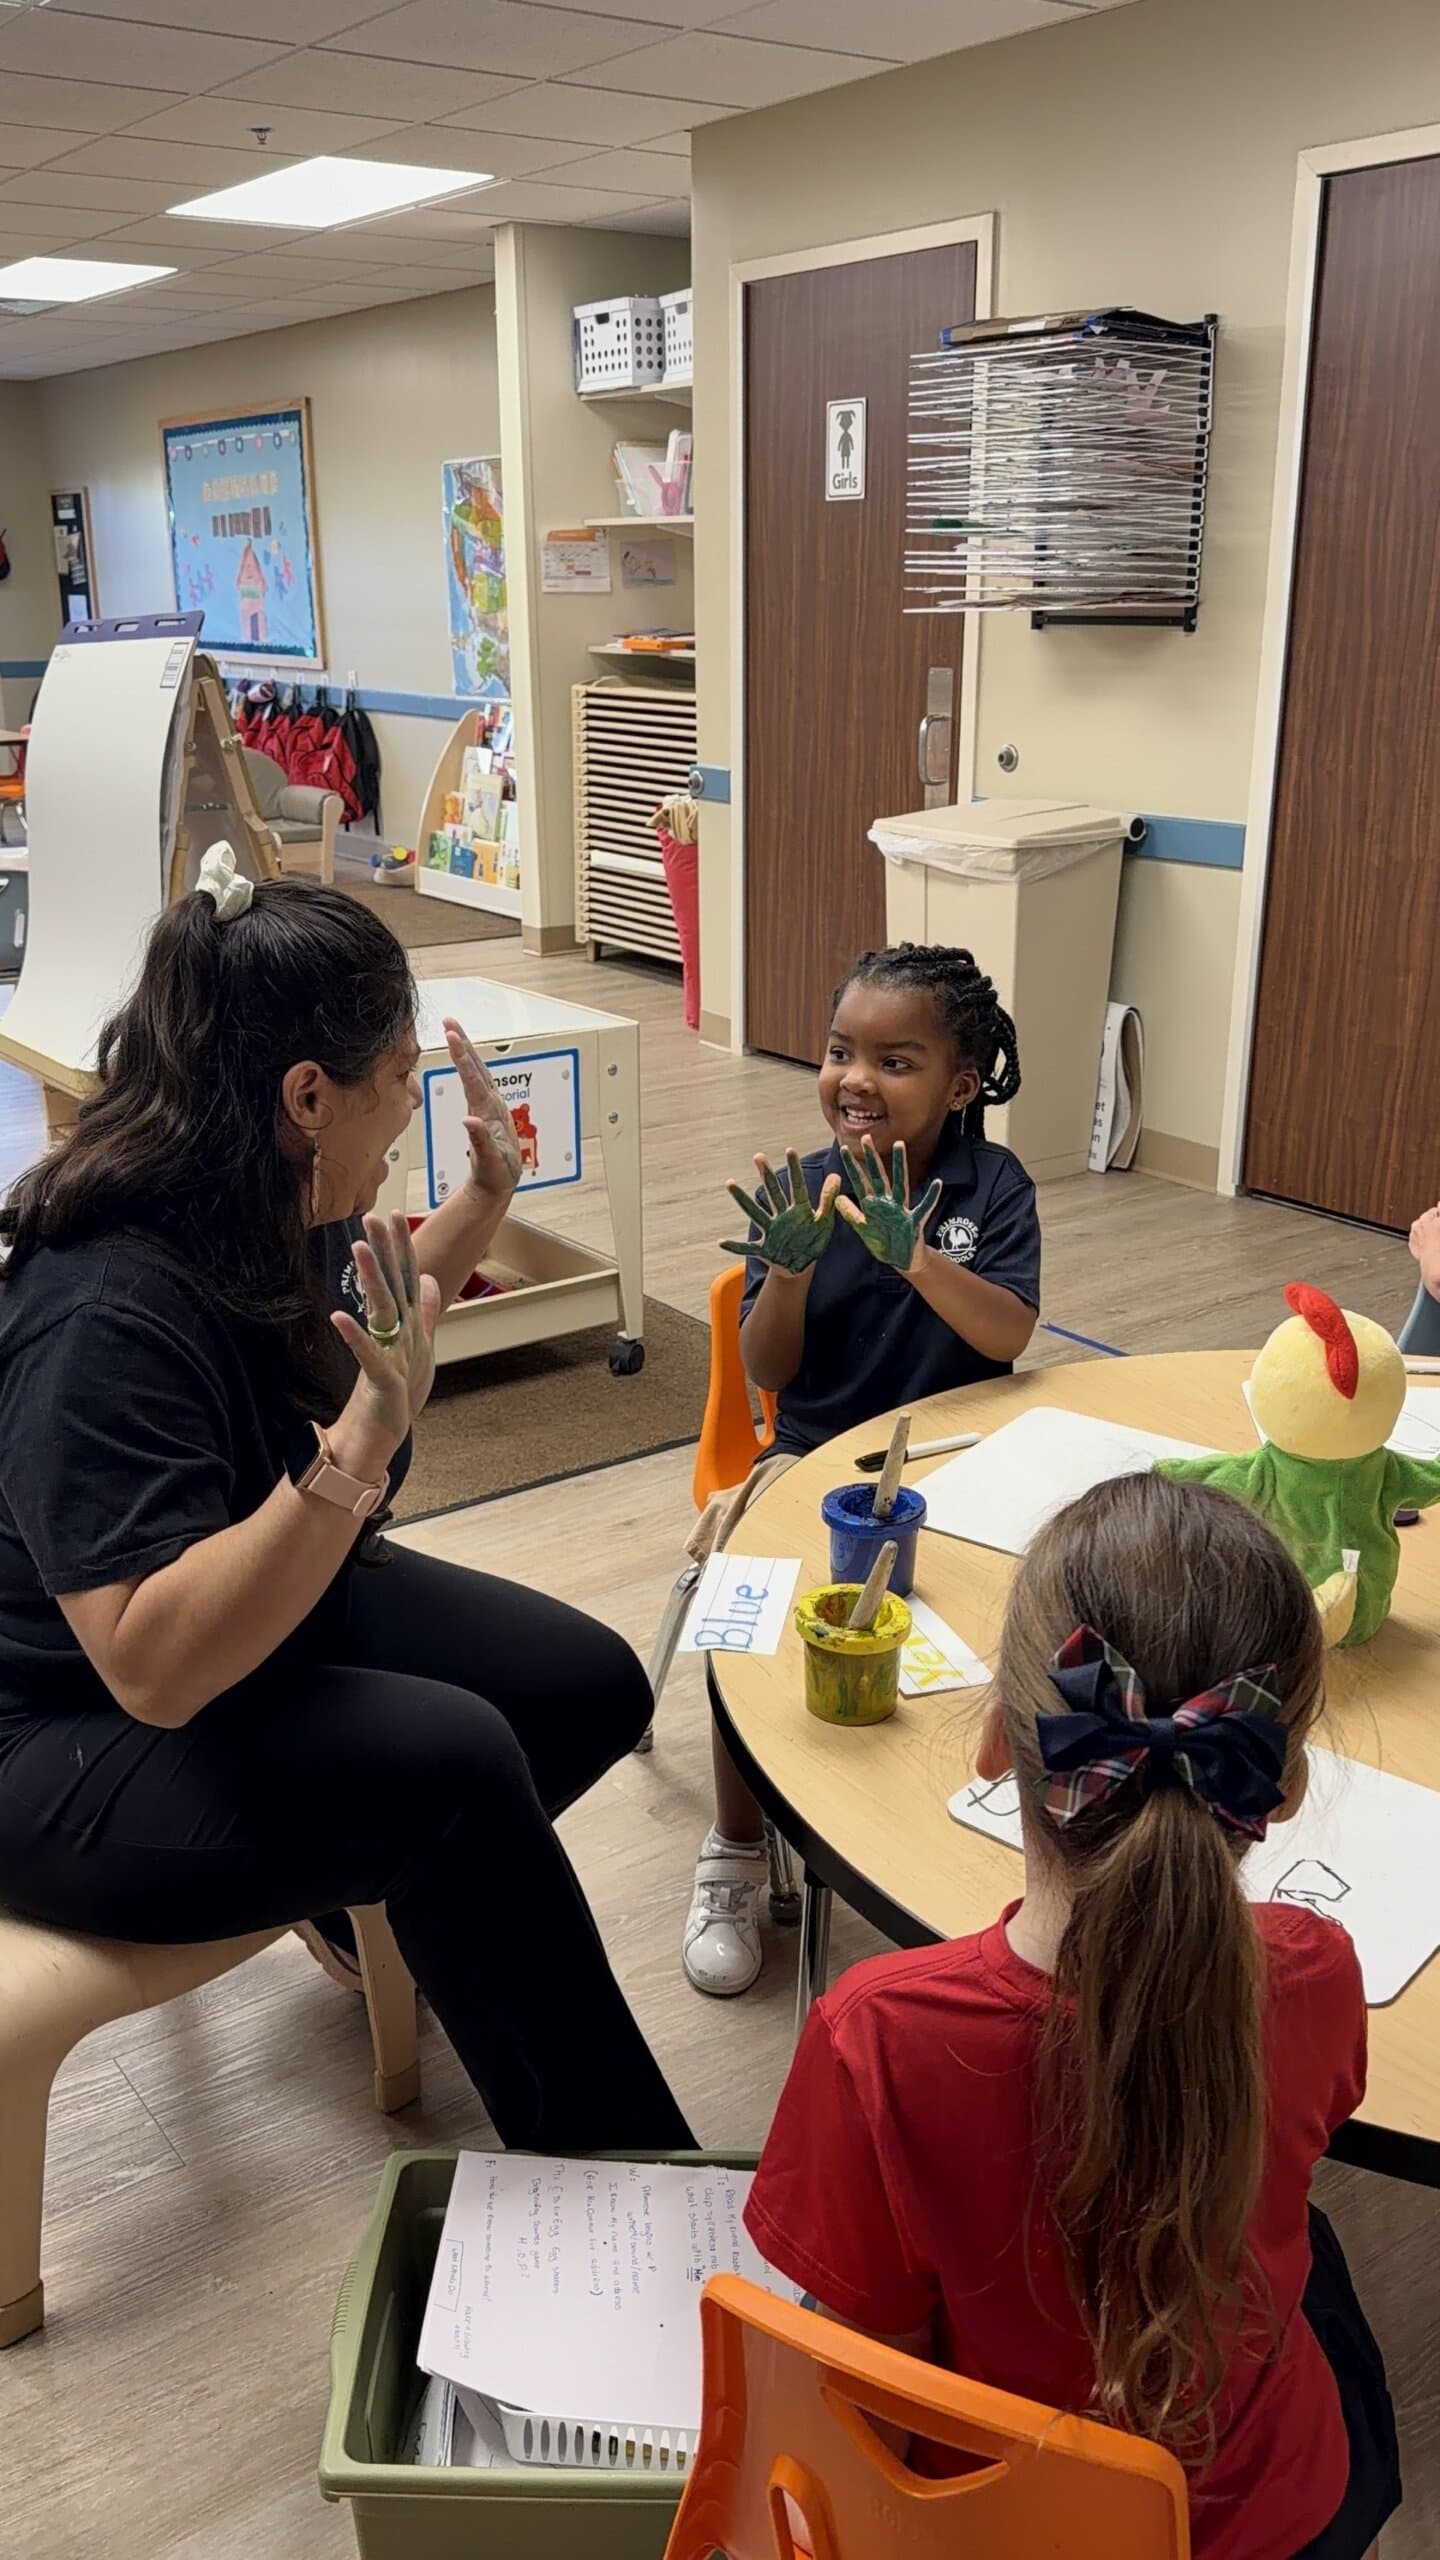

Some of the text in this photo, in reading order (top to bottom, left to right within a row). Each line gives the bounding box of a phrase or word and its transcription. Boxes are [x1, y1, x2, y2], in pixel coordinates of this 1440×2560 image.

[832, 471, 858, 490] Girls
[493, 1072, 532, 1088] nsory
[501, 1087, 530, 1102] orial
[935, 1216, 979, 1238] PRIMROSE
[695, 1584, 769, 1649] Blue
